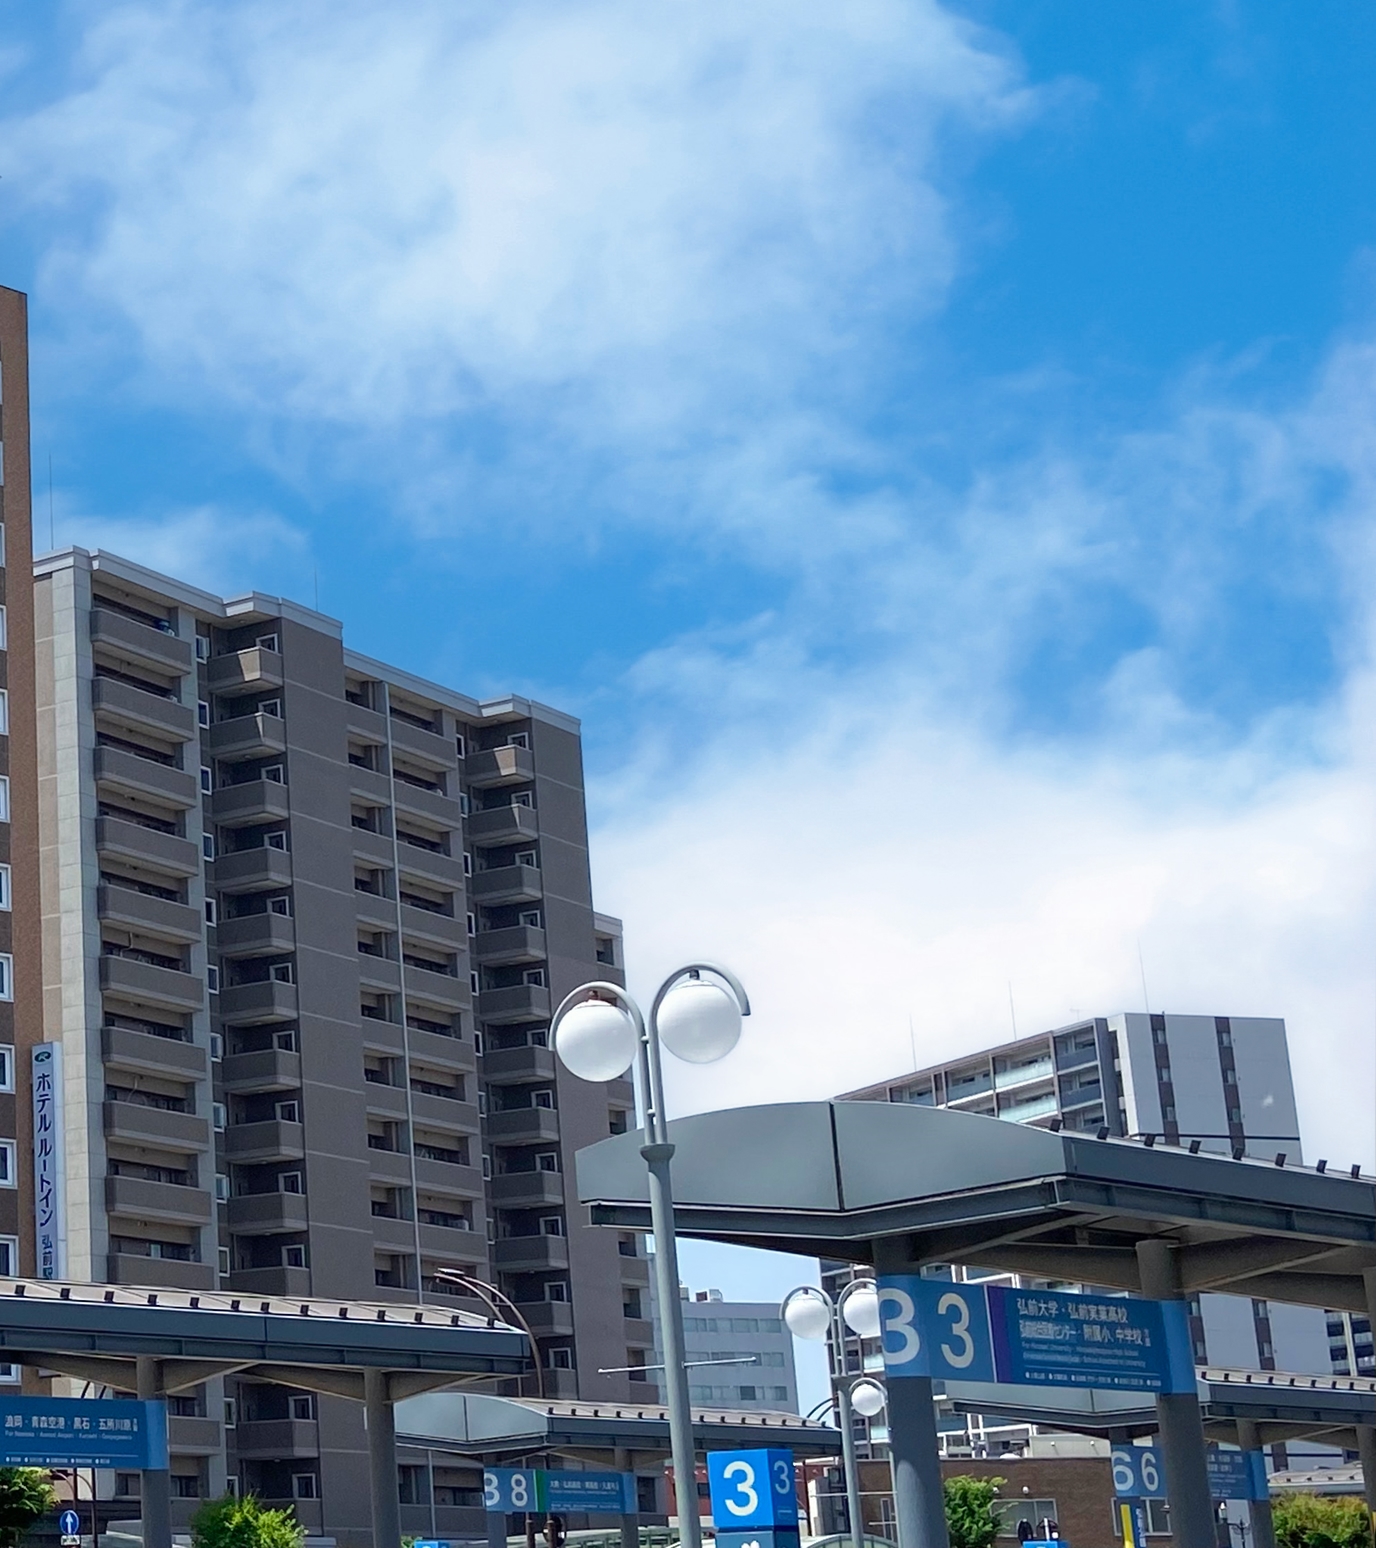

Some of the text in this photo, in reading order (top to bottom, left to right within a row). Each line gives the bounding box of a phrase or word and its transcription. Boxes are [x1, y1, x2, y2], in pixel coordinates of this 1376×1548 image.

[36, 1073, 52, 1132] ホテル
[37, 1137, 54, 1227] ルートイン
[877, 1288, 921, 1365] 3
[937, 1292, 975, 1369] 3
[510, 1473, 528, 1507] 8
[723, 1460, 759, 1516] 3
[773, 1460, 791, 1494] 3
[1112, 1451, 1135, 1491] 6
[1141, 1452, 1159, 1492] 6
